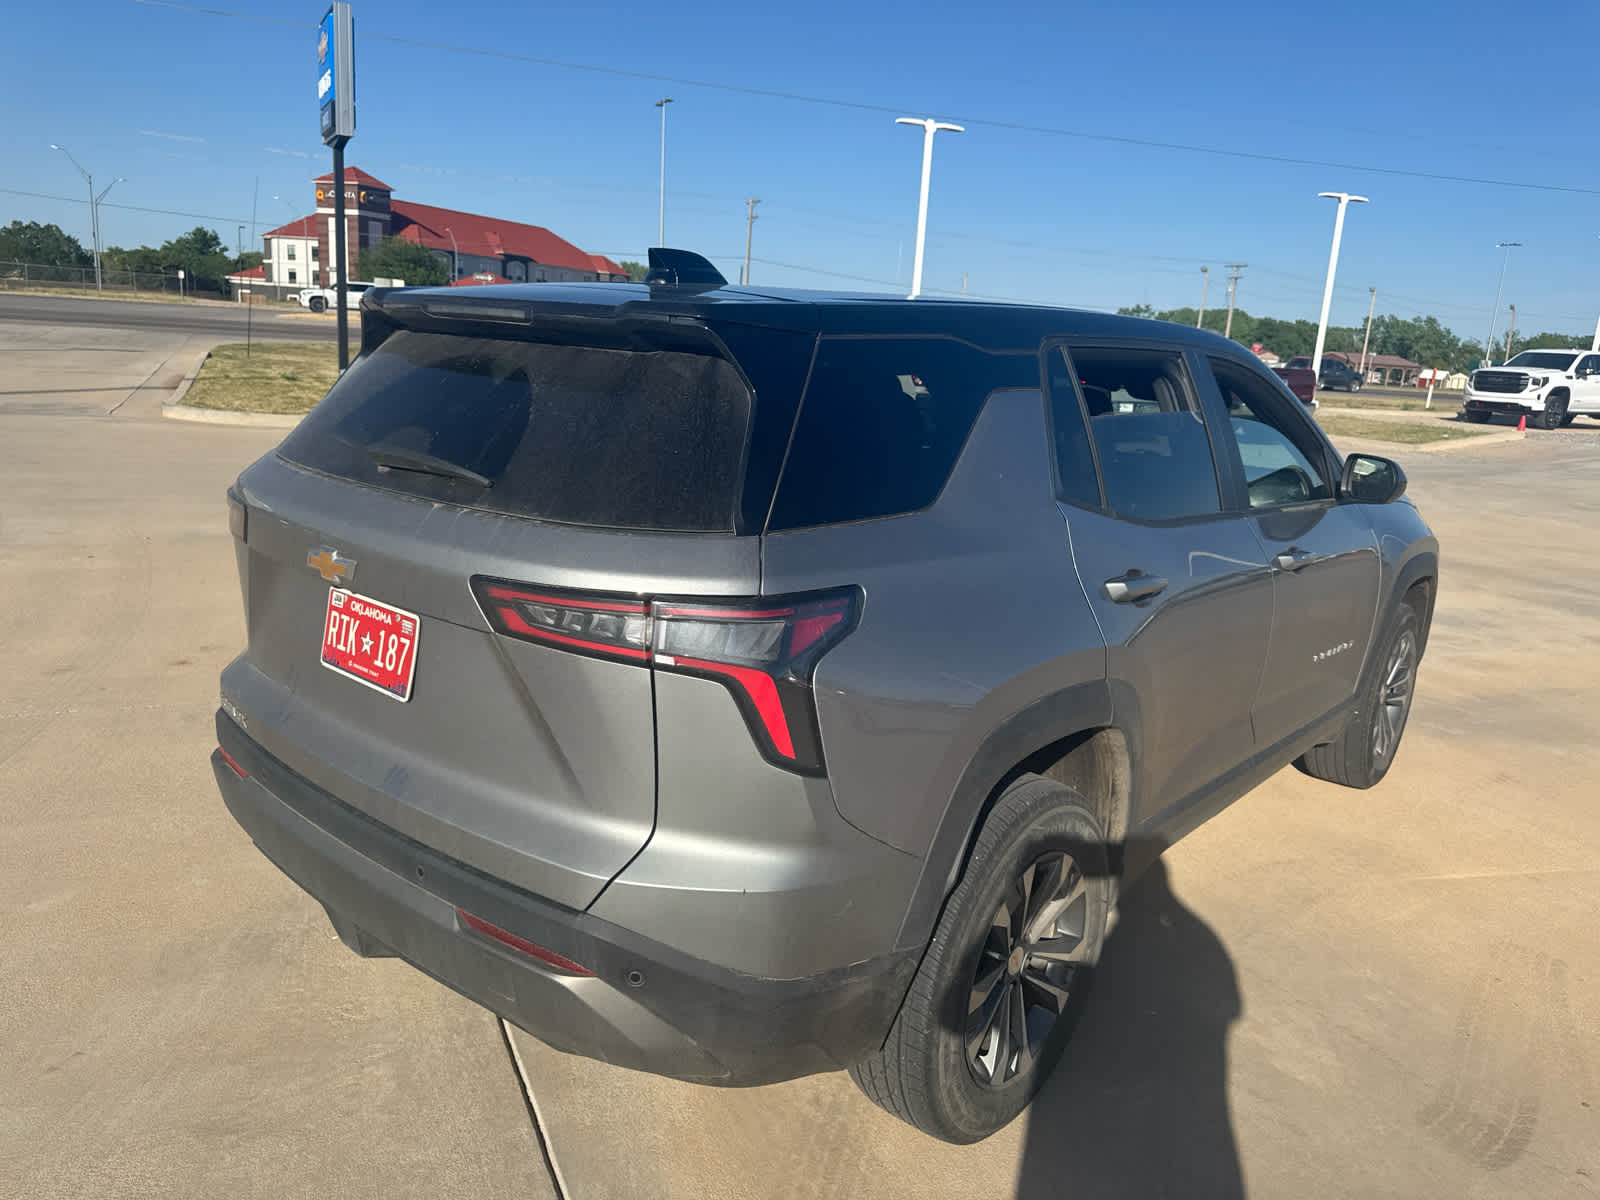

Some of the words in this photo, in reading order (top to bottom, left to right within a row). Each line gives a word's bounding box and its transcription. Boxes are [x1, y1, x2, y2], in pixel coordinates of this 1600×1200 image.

[350, 600, 392, 625] OKLAHOMA
[327, 610, 360, 656] RIK
[373, 629, 410, 676] 187
